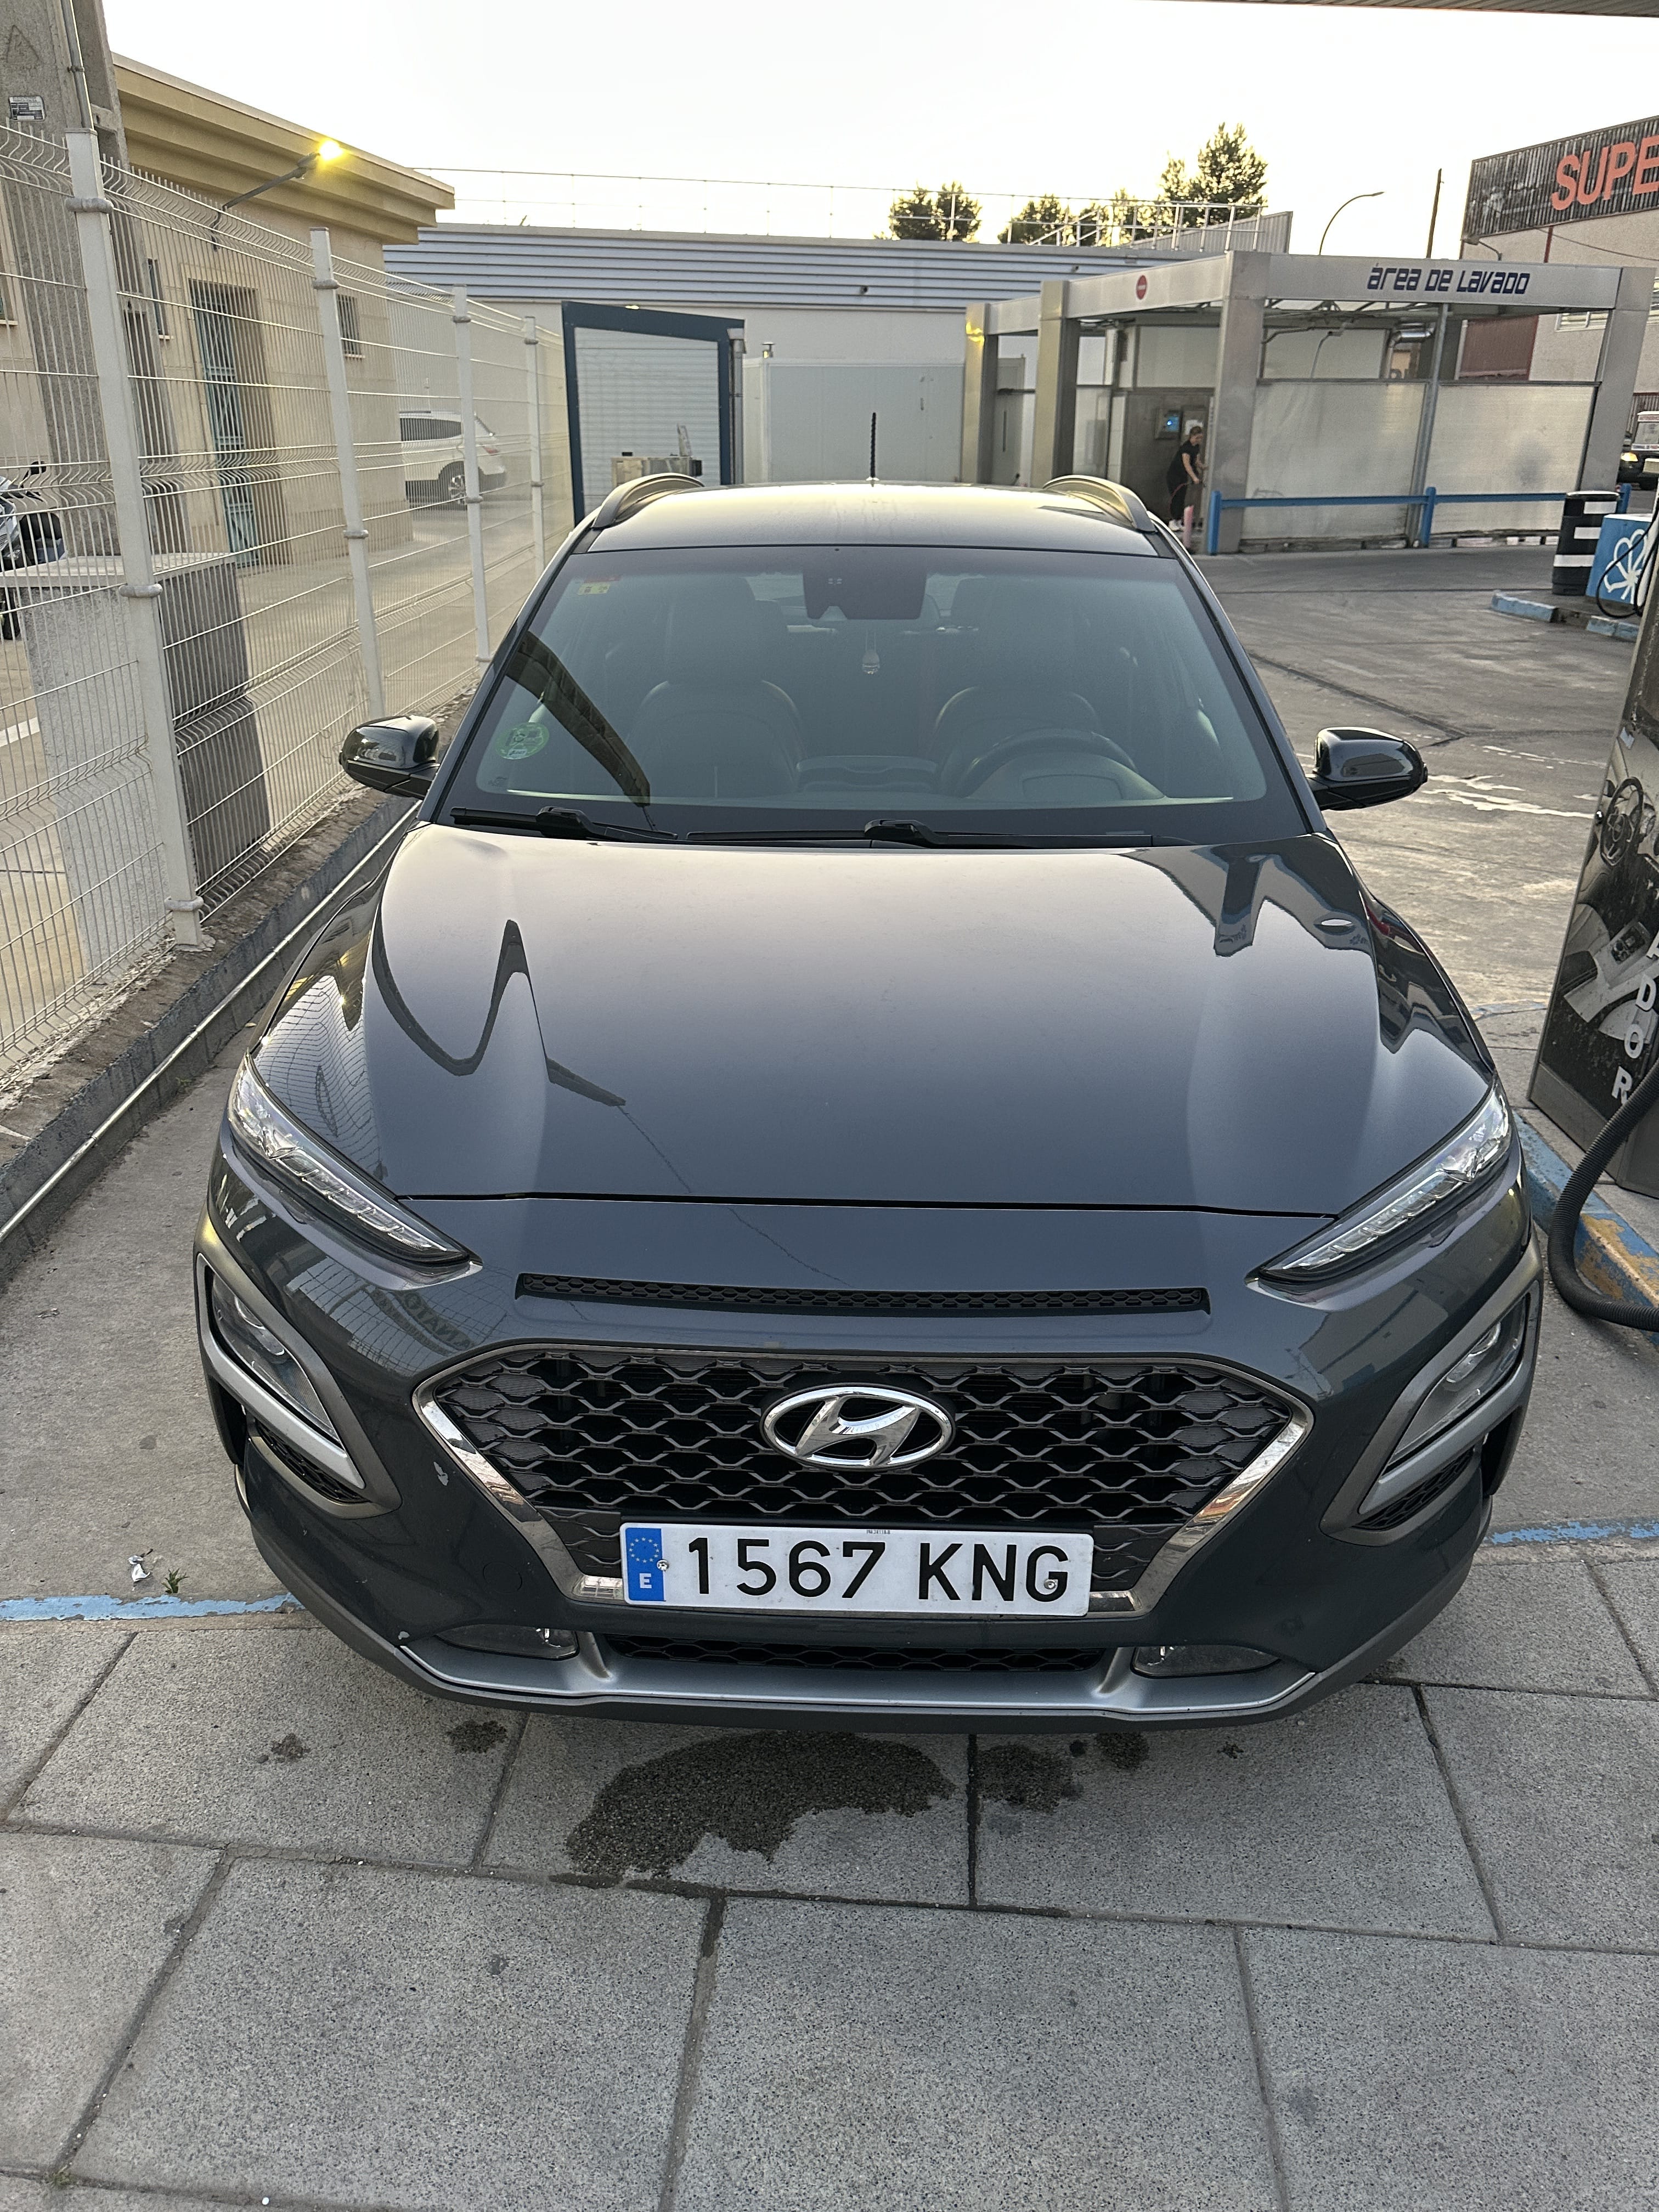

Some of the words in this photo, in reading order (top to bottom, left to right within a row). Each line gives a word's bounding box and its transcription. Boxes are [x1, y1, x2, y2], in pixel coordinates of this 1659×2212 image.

[639, 1573, 652, 1589] E
[689, 1537, 885, 1599] 1567
[918, 1543, 1069, 1602] KNG
